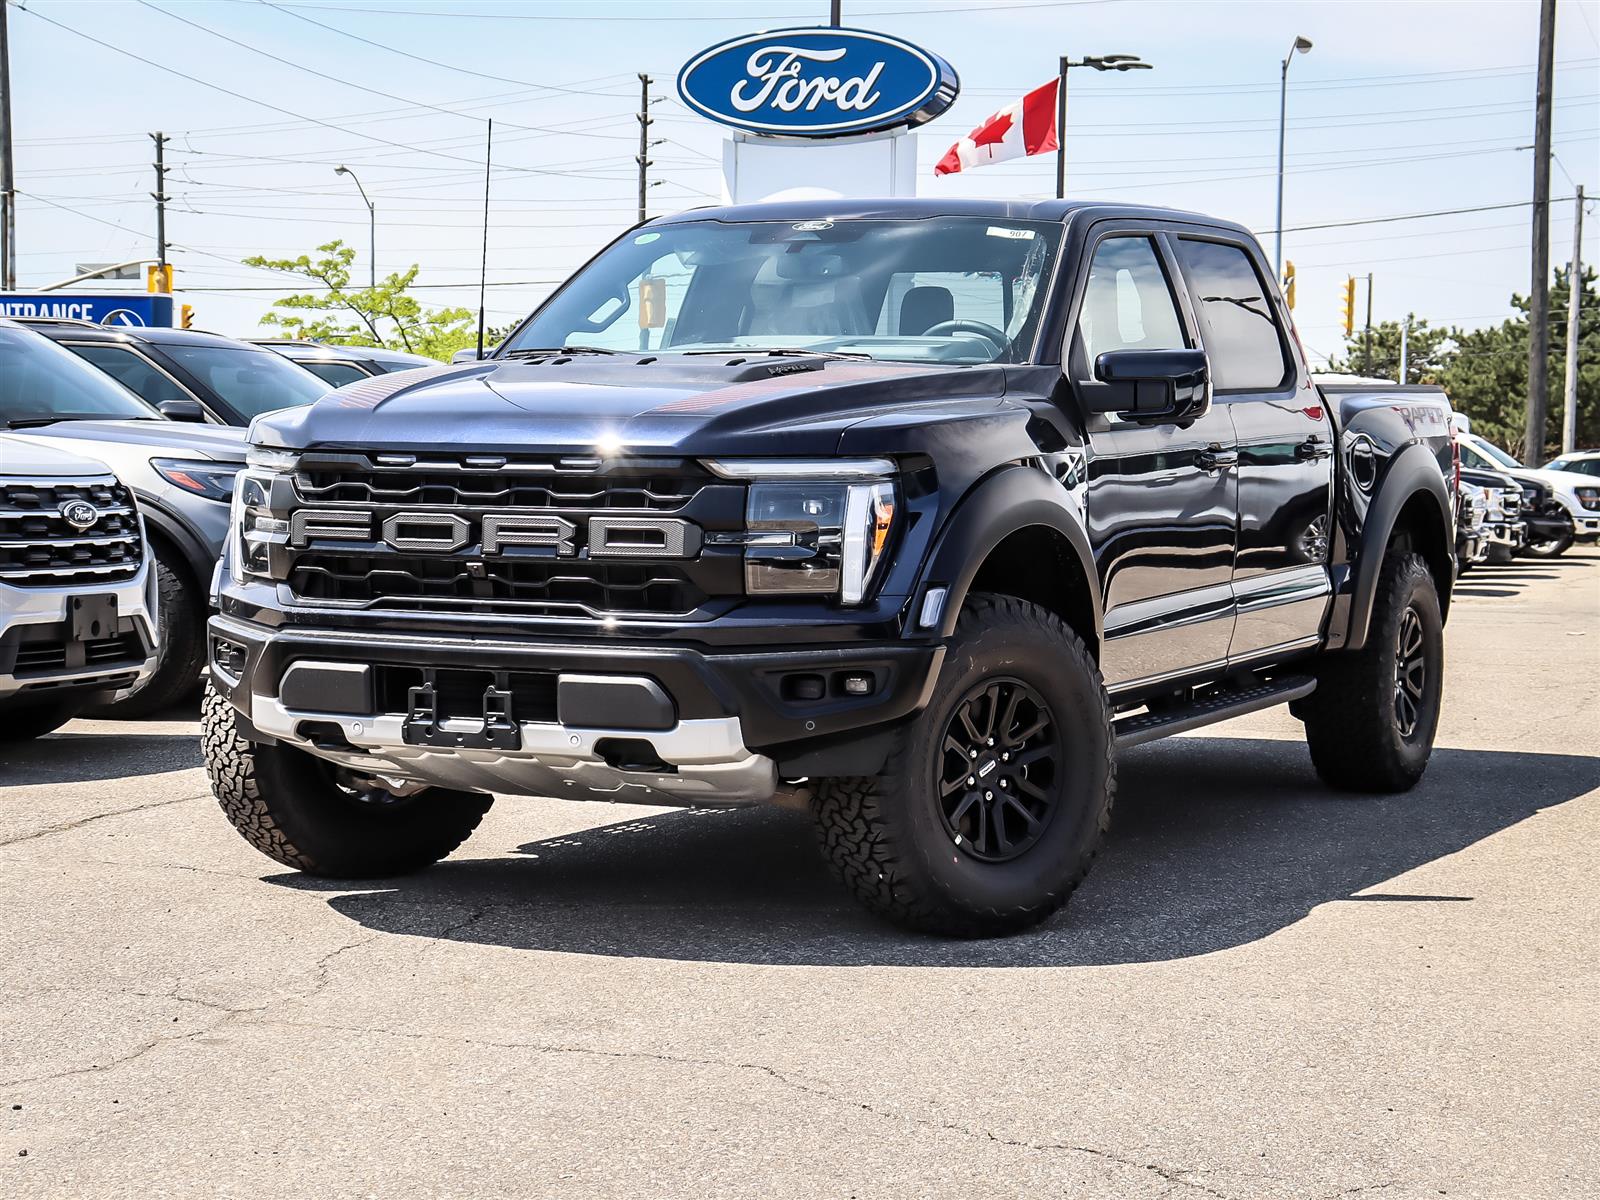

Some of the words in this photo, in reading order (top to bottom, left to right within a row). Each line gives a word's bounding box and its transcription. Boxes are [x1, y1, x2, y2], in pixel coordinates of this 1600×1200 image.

[731, 46, 885, 112] Ford
[74, 506, 93, 521] Ford
[291, 510, 702, 558] FORD
